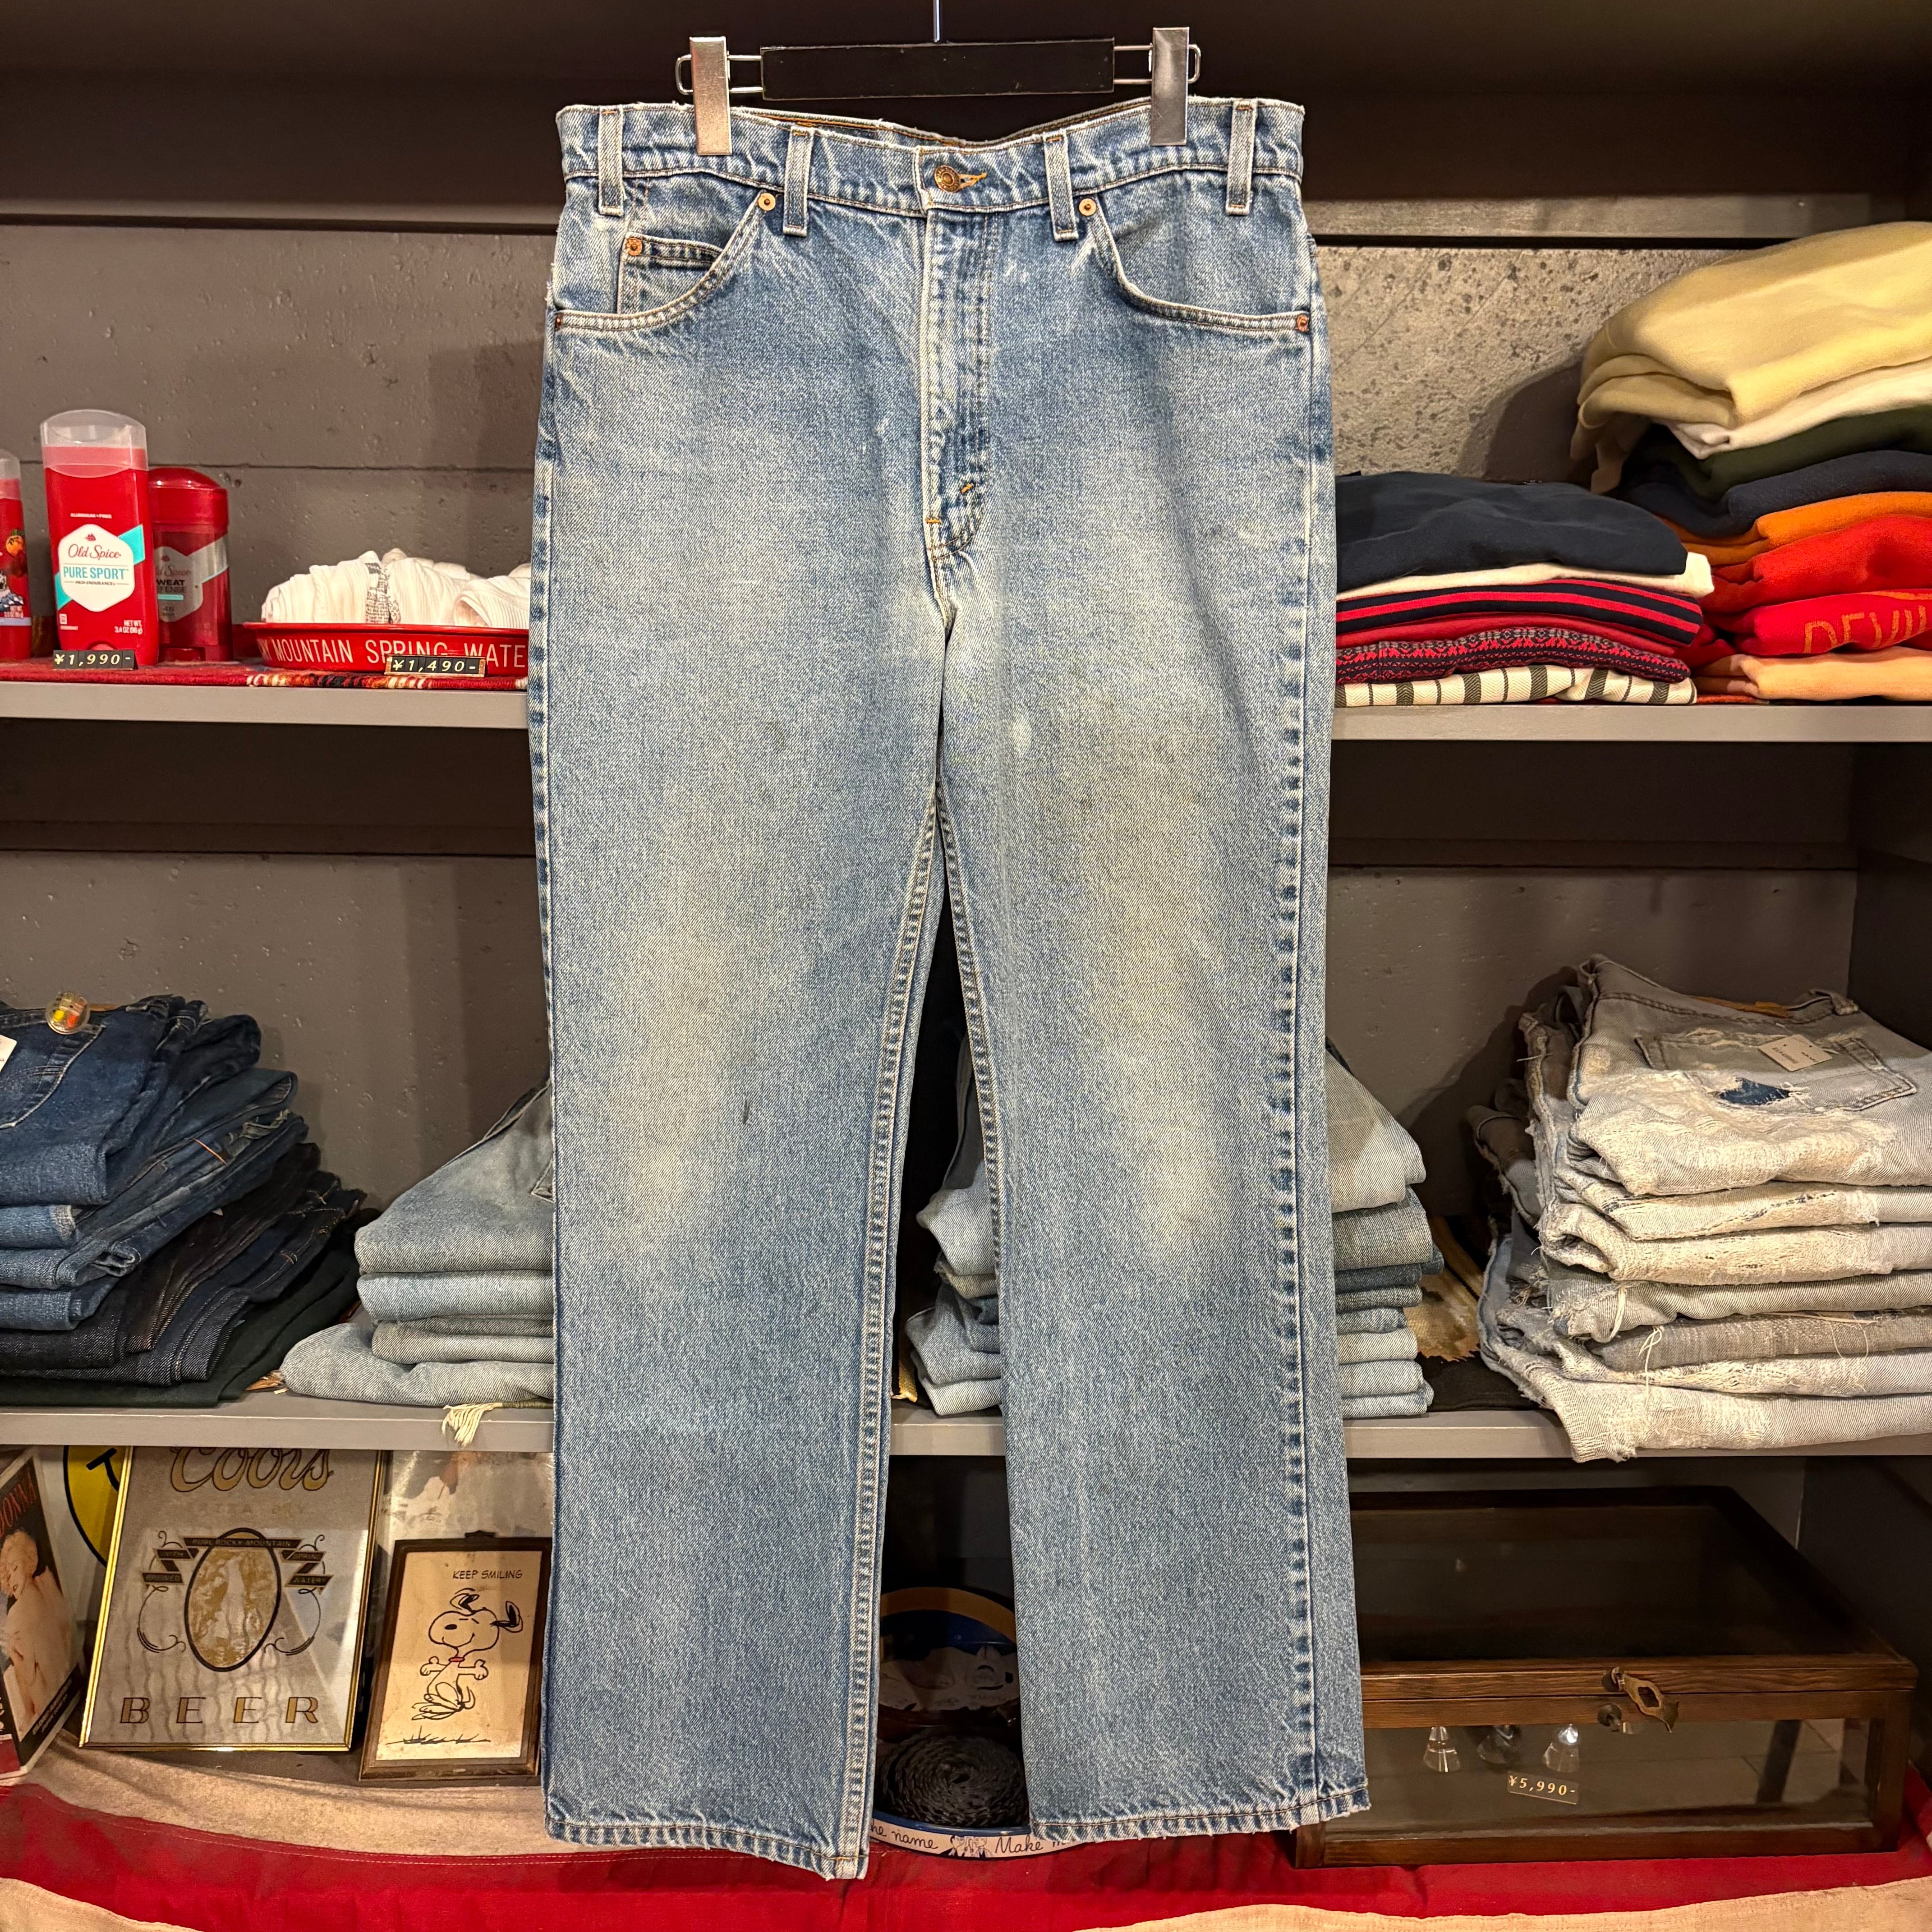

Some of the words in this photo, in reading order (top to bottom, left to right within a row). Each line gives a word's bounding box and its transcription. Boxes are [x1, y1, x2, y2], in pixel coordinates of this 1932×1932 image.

[68, 544, 89, 558] Old
[90, 545, 121, 560] Spice
[63, 566, 88, 579] PURE
[90, 567, 125, 580] SPORT
[271, 639, 354, 663] MOUNTAIN
[464, 643, 526, 667] WATE
[453, 1570, 478, 1579] KEEP
[482, 1569, 523, 1579] SMILING
[120, 1697, 319, 1724] BEER
[870, 1818, 887, 1837] he
[892, 1831, 938, 1849] name
[995, 1834, 1044, 1854] Make
